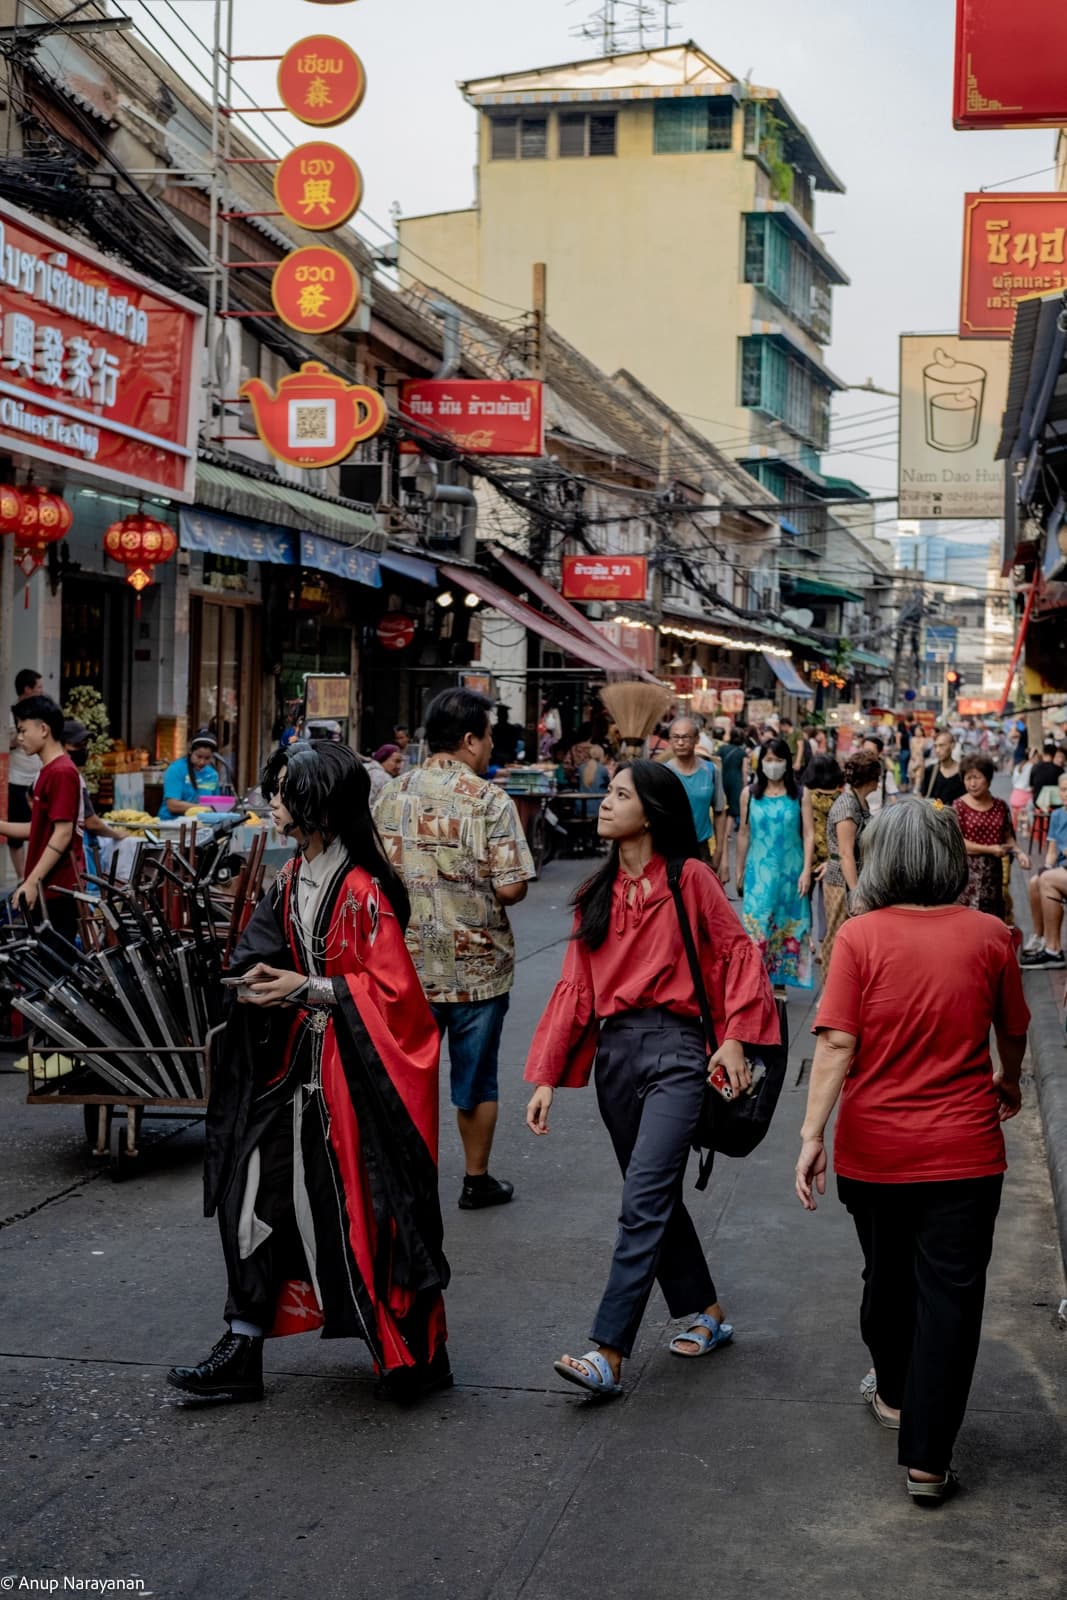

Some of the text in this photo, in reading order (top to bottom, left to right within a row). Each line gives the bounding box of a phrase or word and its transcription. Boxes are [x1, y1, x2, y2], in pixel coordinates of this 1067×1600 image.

[297, 177, 337, 216] 興
[296, 283, 332, 318] 發
[0, 312, 120, 407] 興發茶行
[1, 397, 48, 439] Chinese
[50, 415, 72, 446] Tea
[902, 468, 937, 483] Nam
[941, 469, 971, 483] Dao
